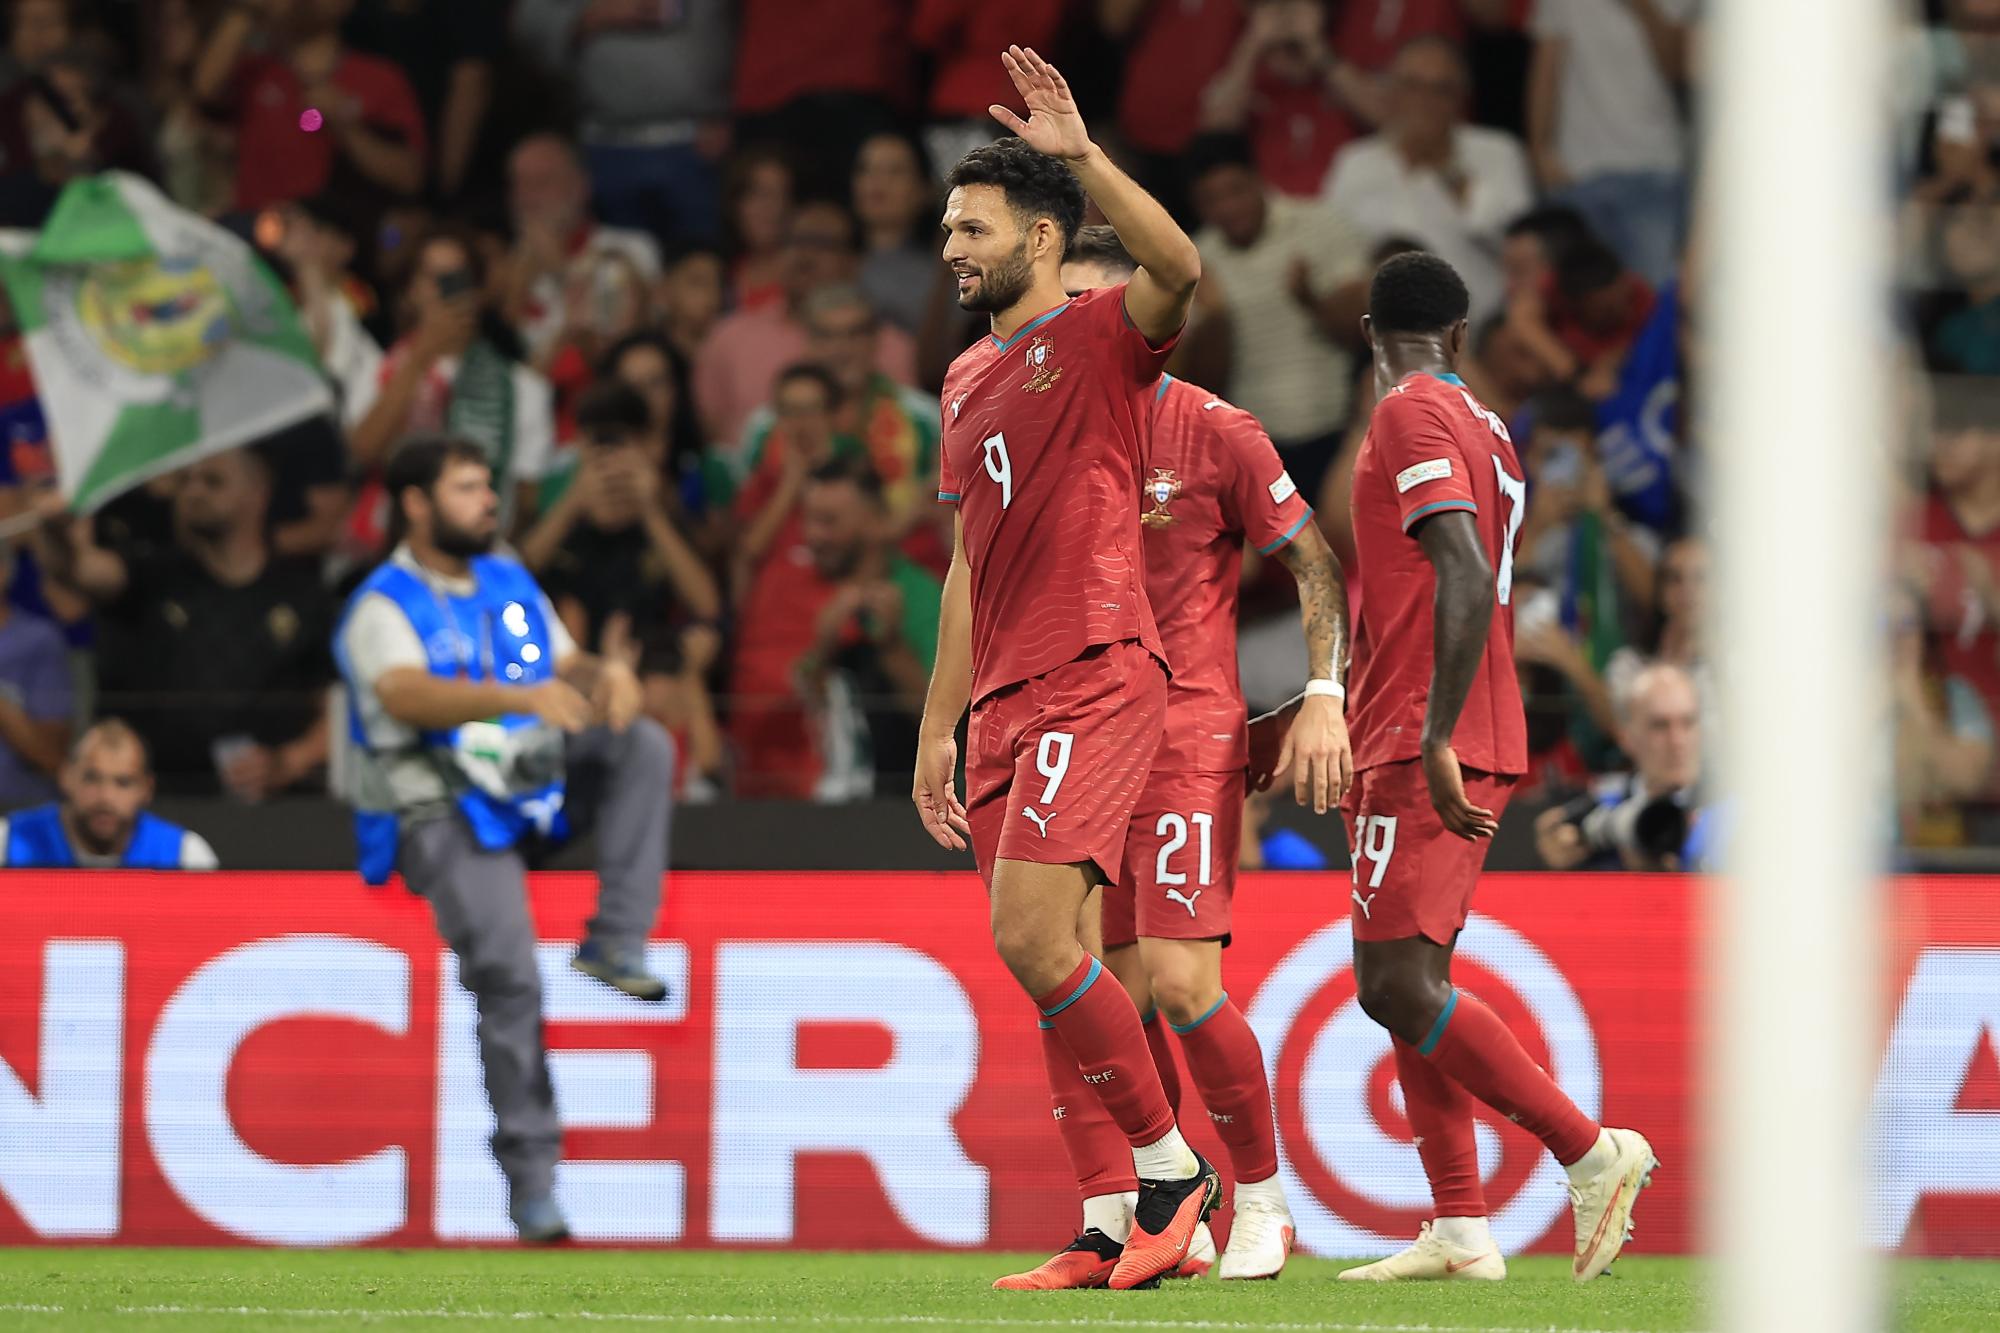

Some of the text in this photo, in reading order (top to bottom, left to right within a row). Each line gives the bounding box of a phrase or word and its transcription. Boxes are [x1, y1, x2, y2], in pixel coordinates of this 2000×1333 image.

[983, 431, 1012, 509] 9
[1035, 731, 1075, 805] 9
[1155, 812, 1214, 886] 21
